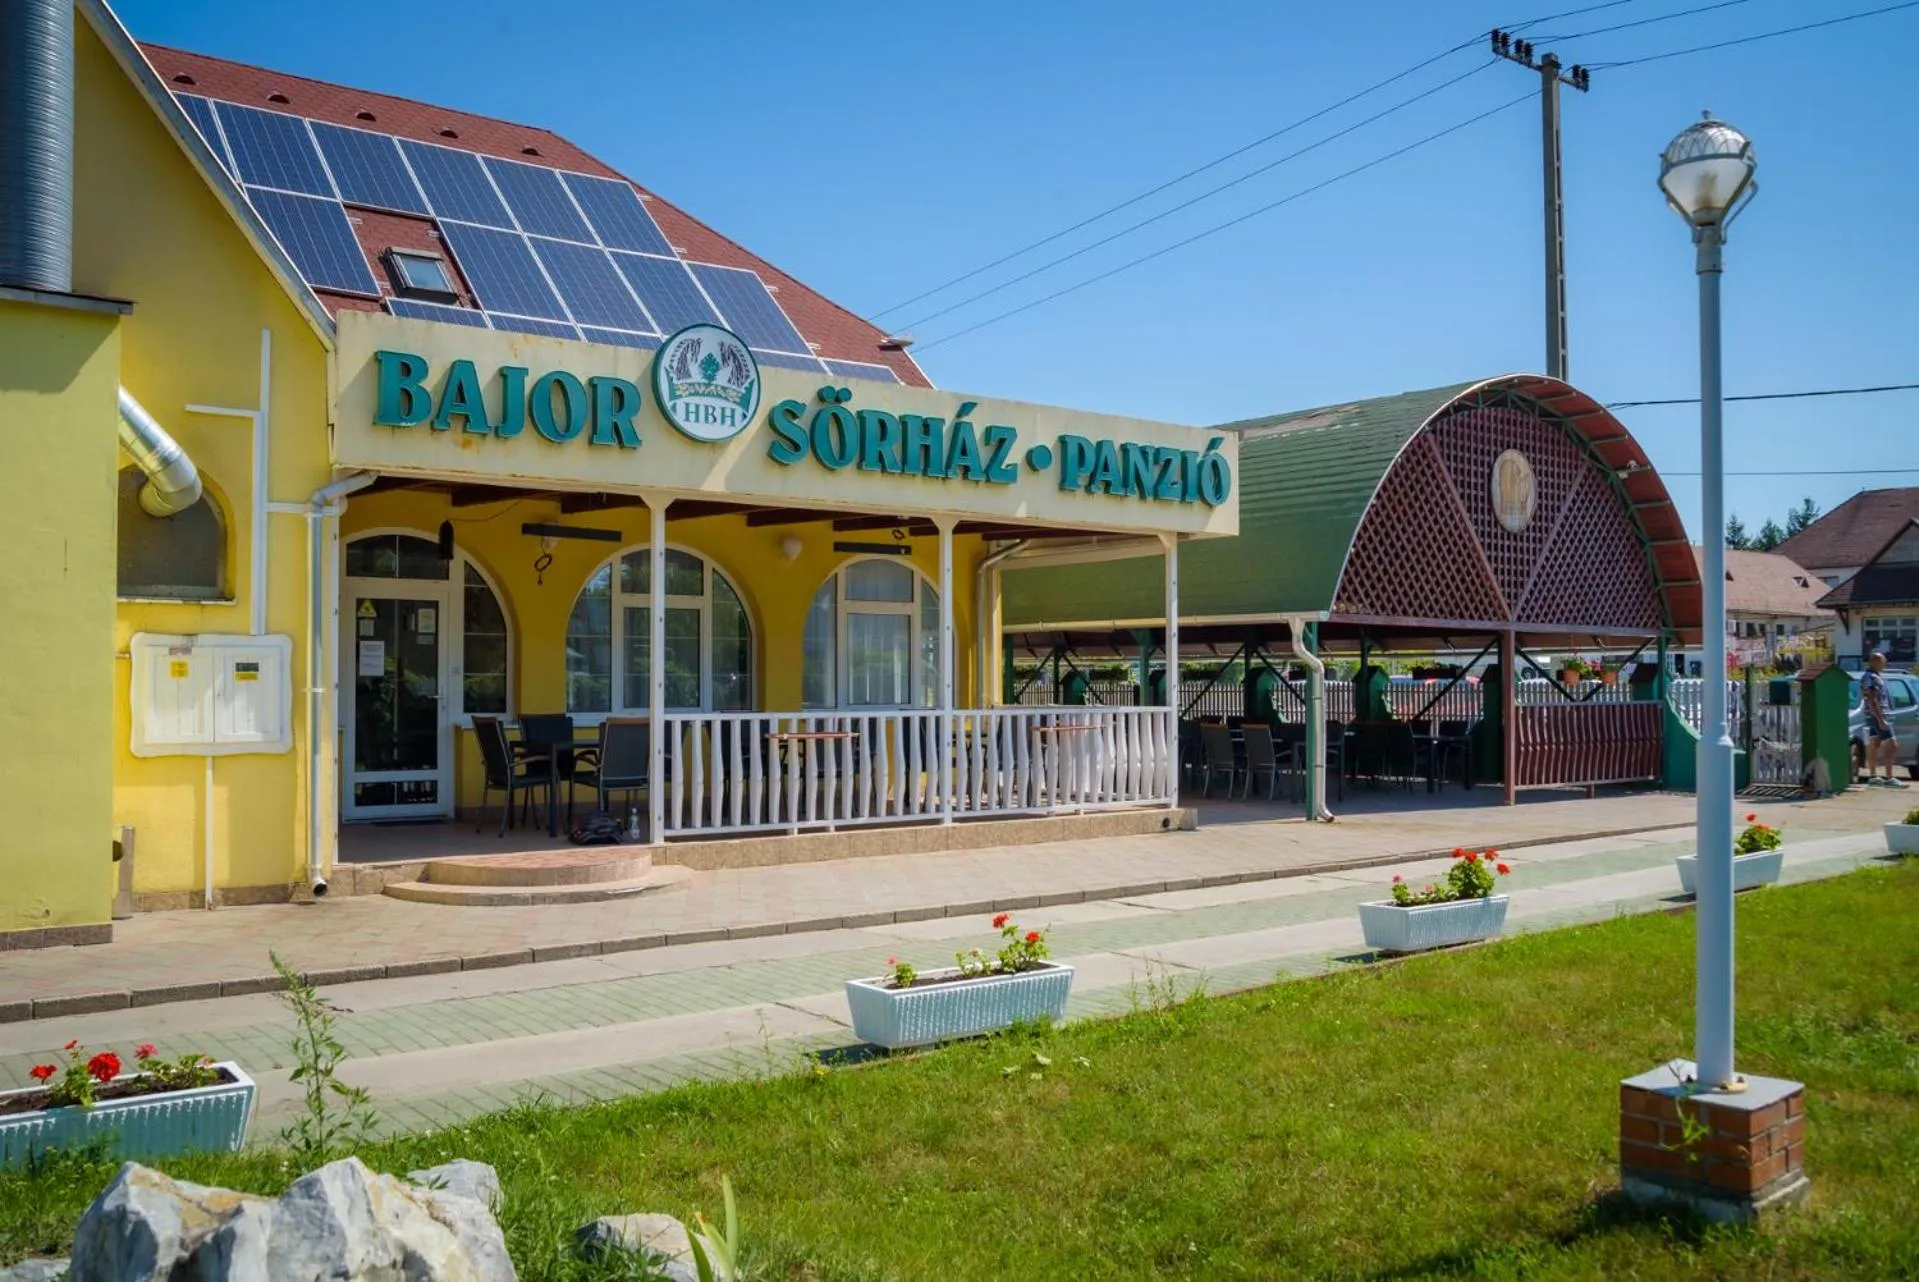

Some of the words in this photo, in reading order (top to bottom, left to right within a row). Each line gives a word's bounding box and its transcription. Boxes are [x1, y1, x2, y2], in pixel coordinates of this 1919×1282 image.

[374, 350, 643, 449] BAJOR
[766, 385, 1019, 485] SÖRHÁZ
[1057, 436, 1231, 507] PANZIÓ
[683, 402, 737, 427] HBH
